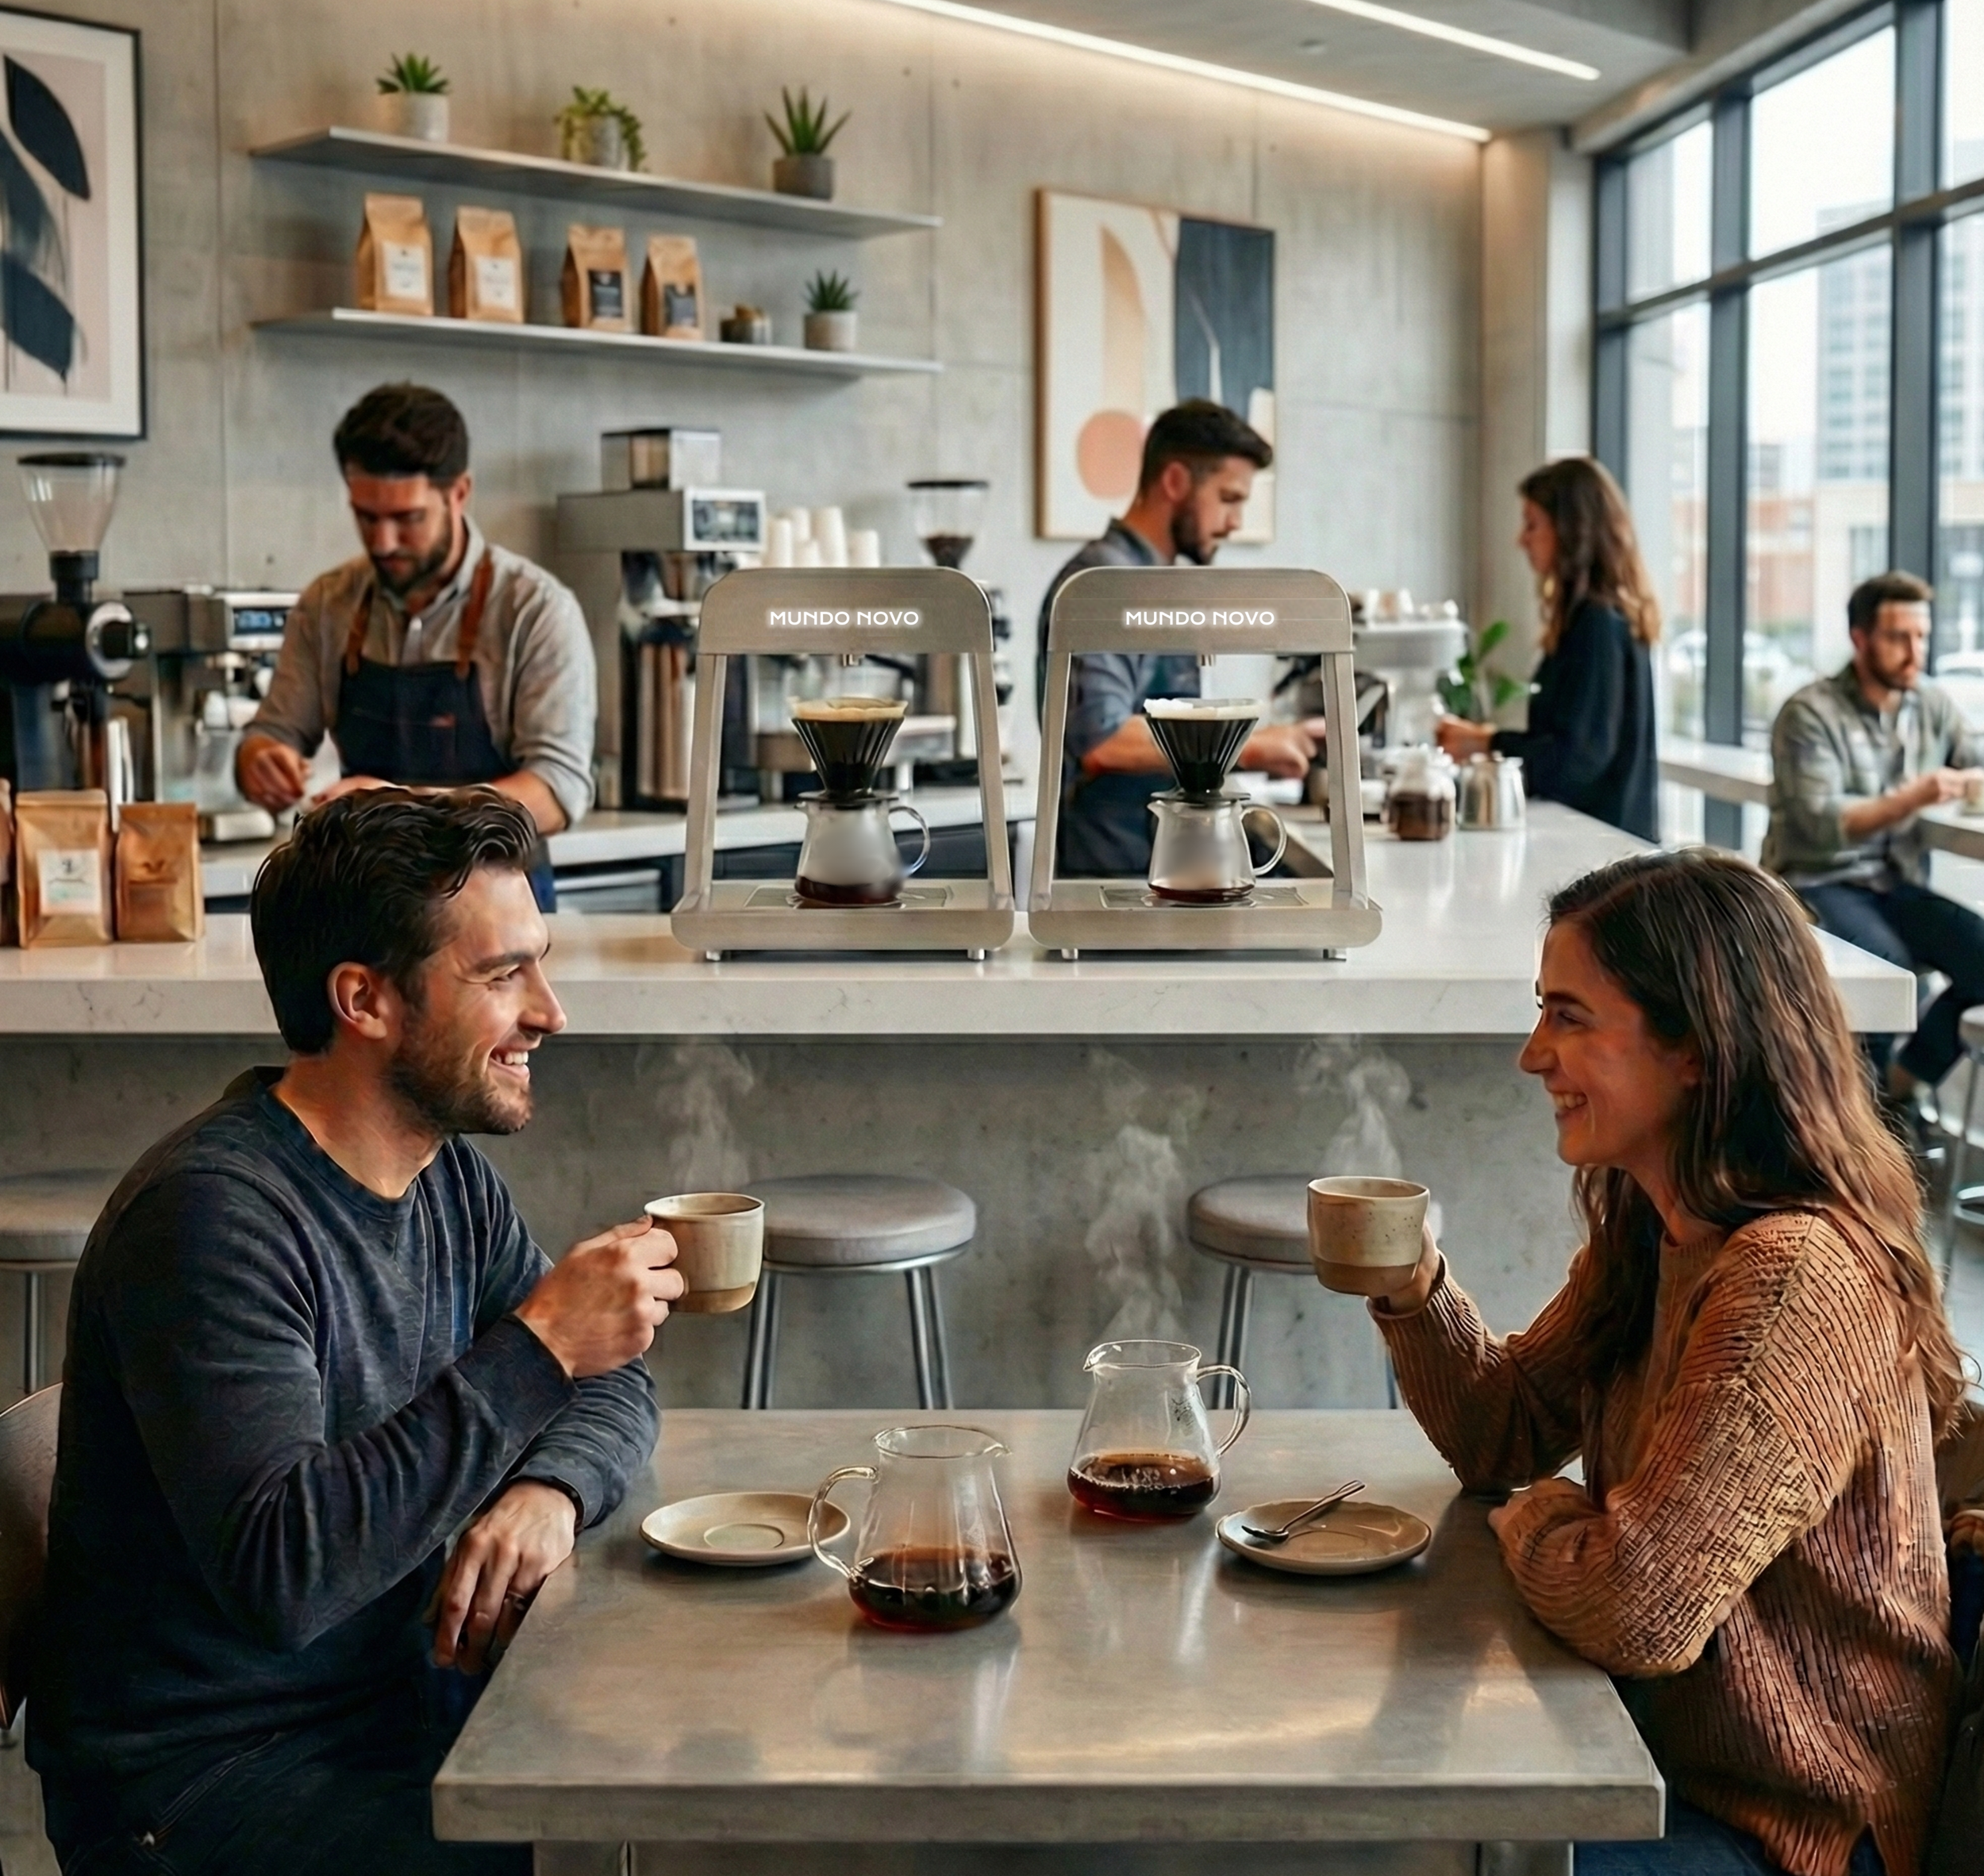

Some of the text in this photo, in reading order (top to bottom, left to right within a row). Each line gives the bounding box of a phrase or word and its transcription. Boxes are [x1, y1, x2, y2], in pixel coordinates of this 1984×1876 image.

[770, 611, 919, 625] MUNDO NOVO
[1125, 611, 1275, 625] MUNDO NOVO
